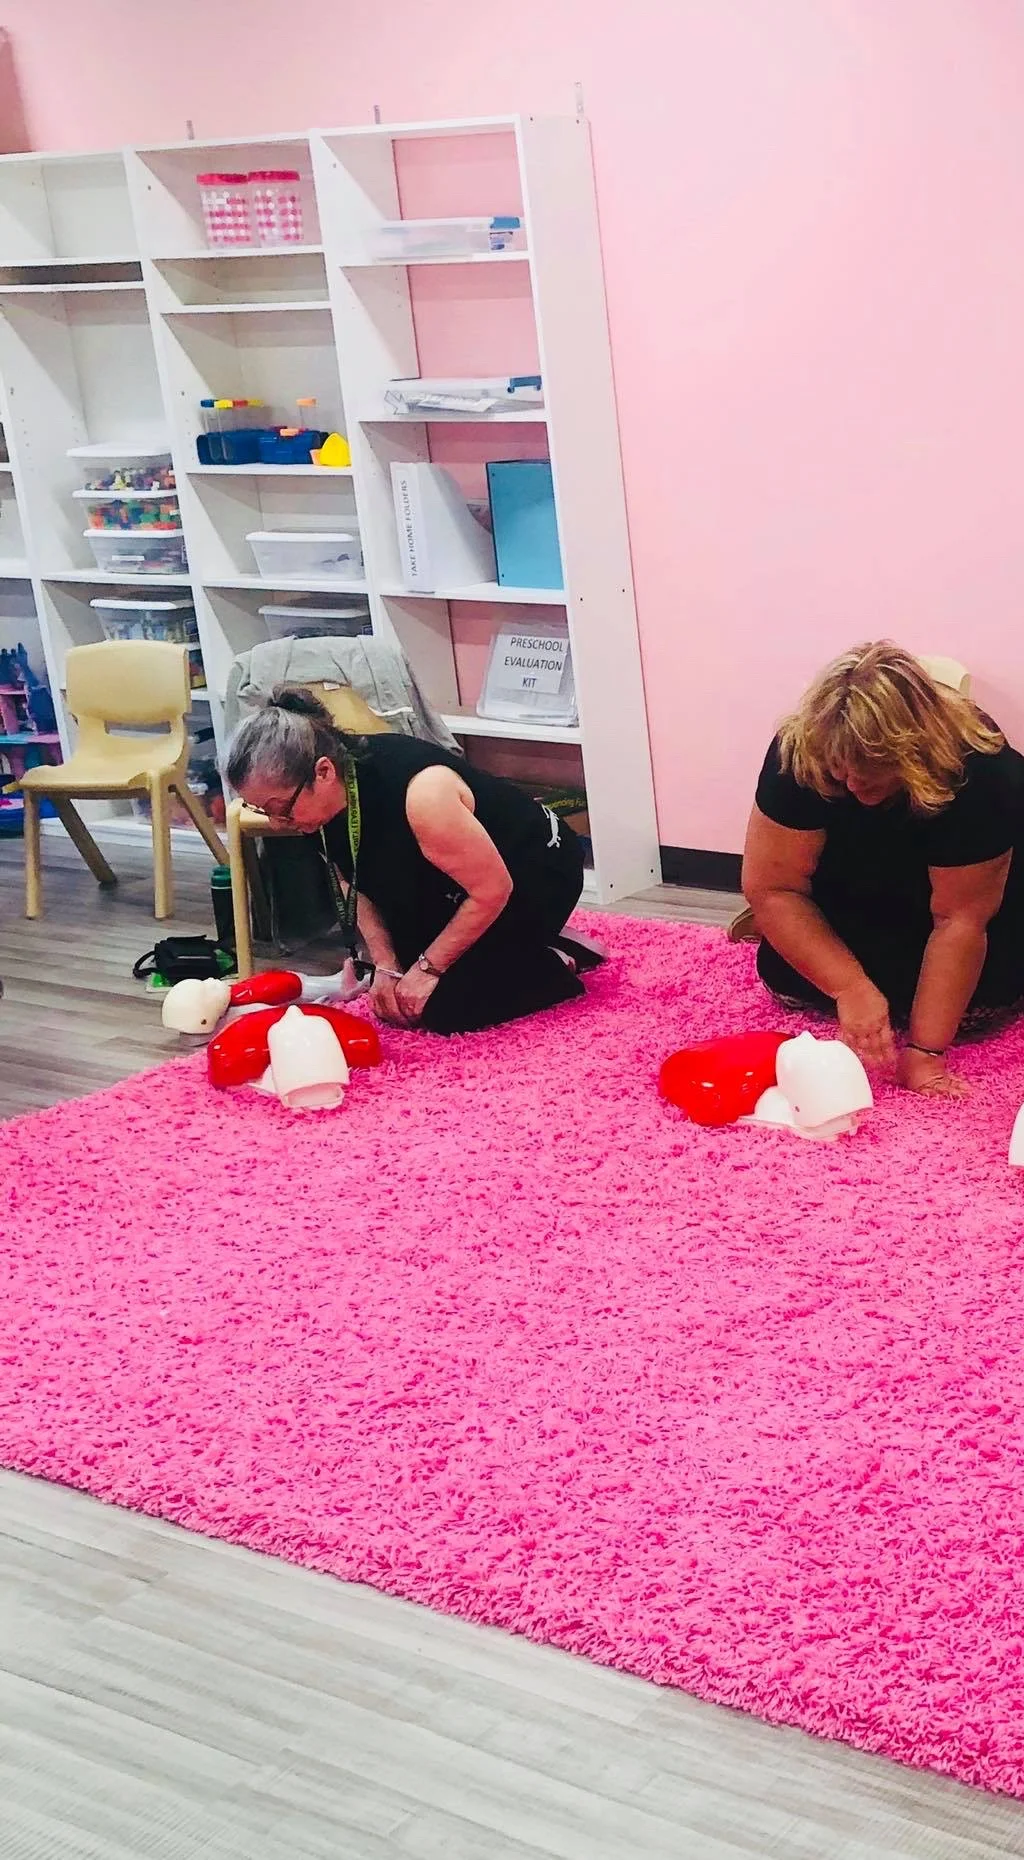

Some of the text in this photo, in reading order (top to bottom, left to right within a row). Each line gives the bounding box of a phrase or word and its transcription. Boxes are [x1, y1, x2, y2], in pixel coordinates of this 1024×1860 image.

[400, 480, 418, 577] TAKE HOME FOLDERS
[510, 637, 563, 652] PRESCHOOL
[504, 656, 562, 671] EVALUATION
[522, 677, 537, 688] KIT
